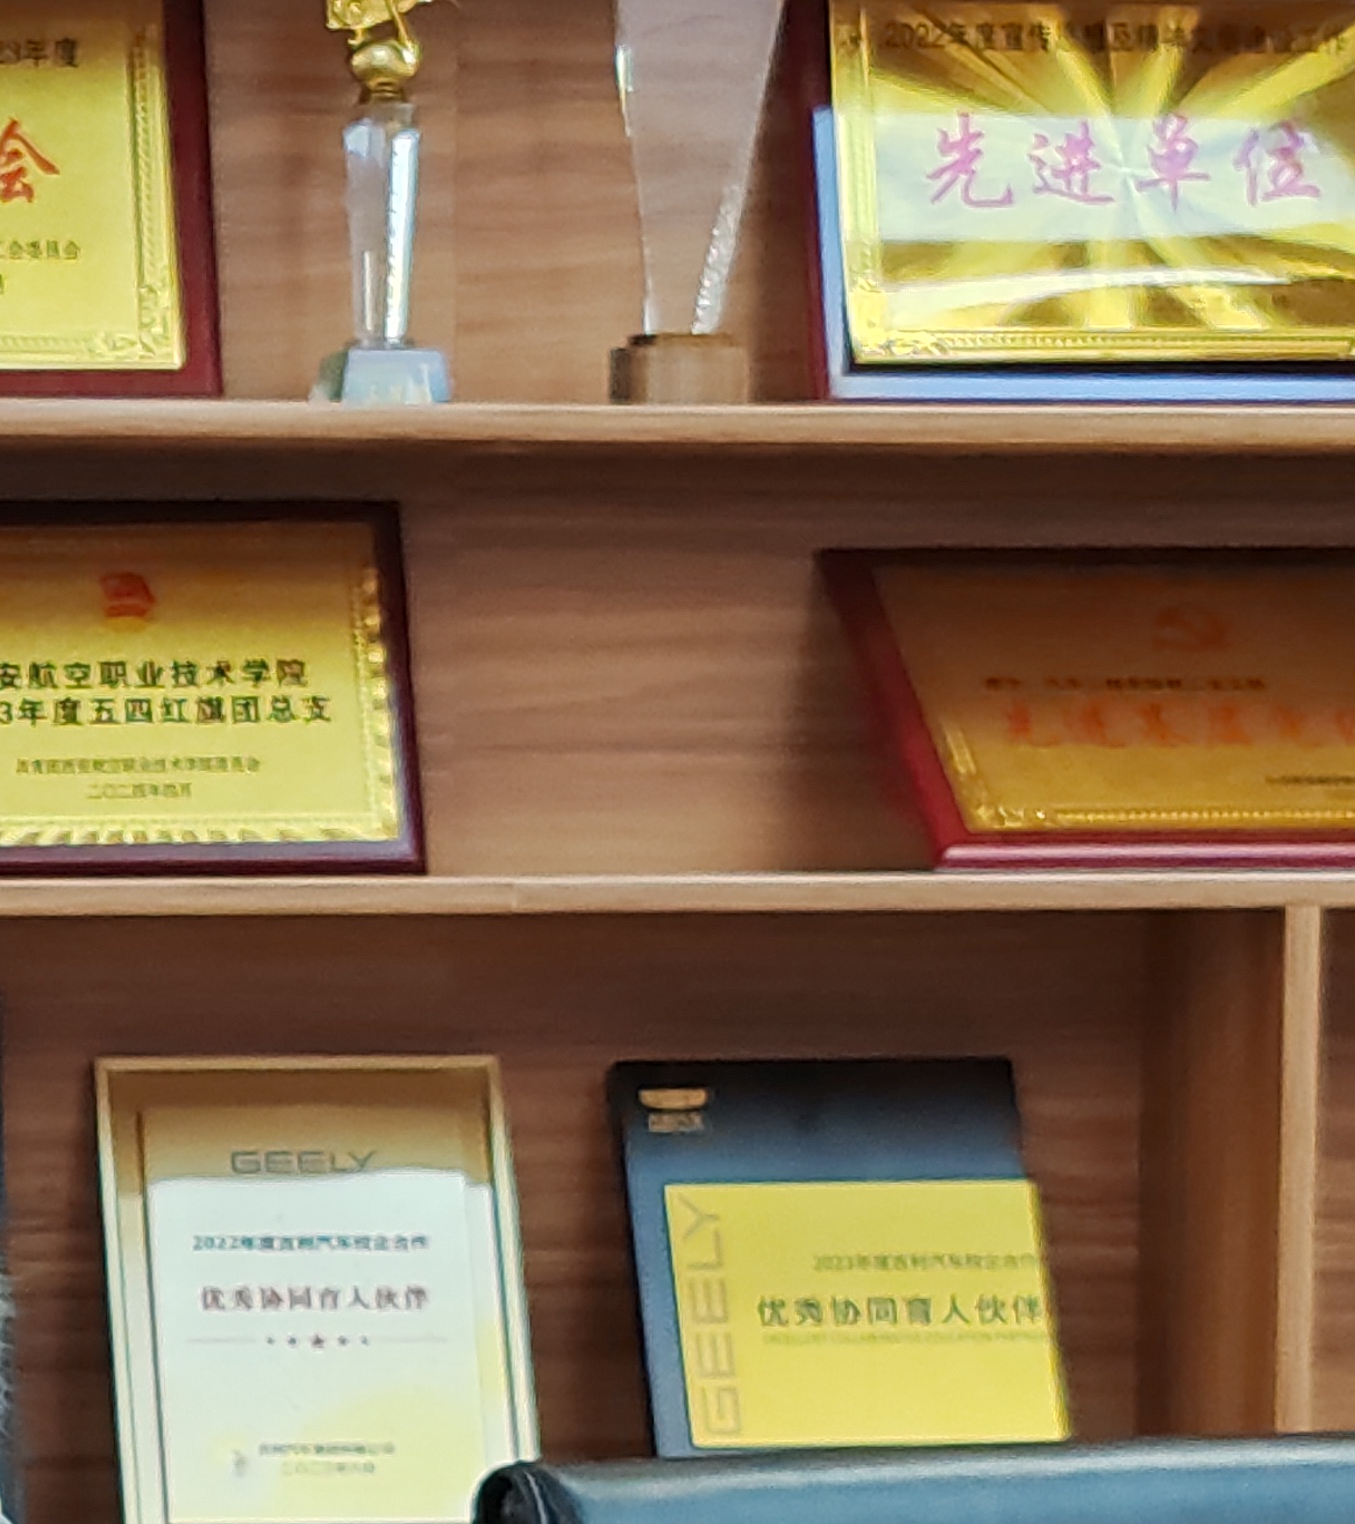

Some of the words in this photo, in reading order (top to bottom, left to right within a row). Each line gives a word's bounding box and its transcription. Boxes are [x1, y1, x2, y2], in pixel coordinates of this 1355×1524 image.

[926, 112, 1321, 211] 先进单位
[230, 1150, 376, 1175] GEELY
[680, 1195, 742, 1436] GEELY
[757, 1294, 1041, 1327] 优秀协同育人伙伴
